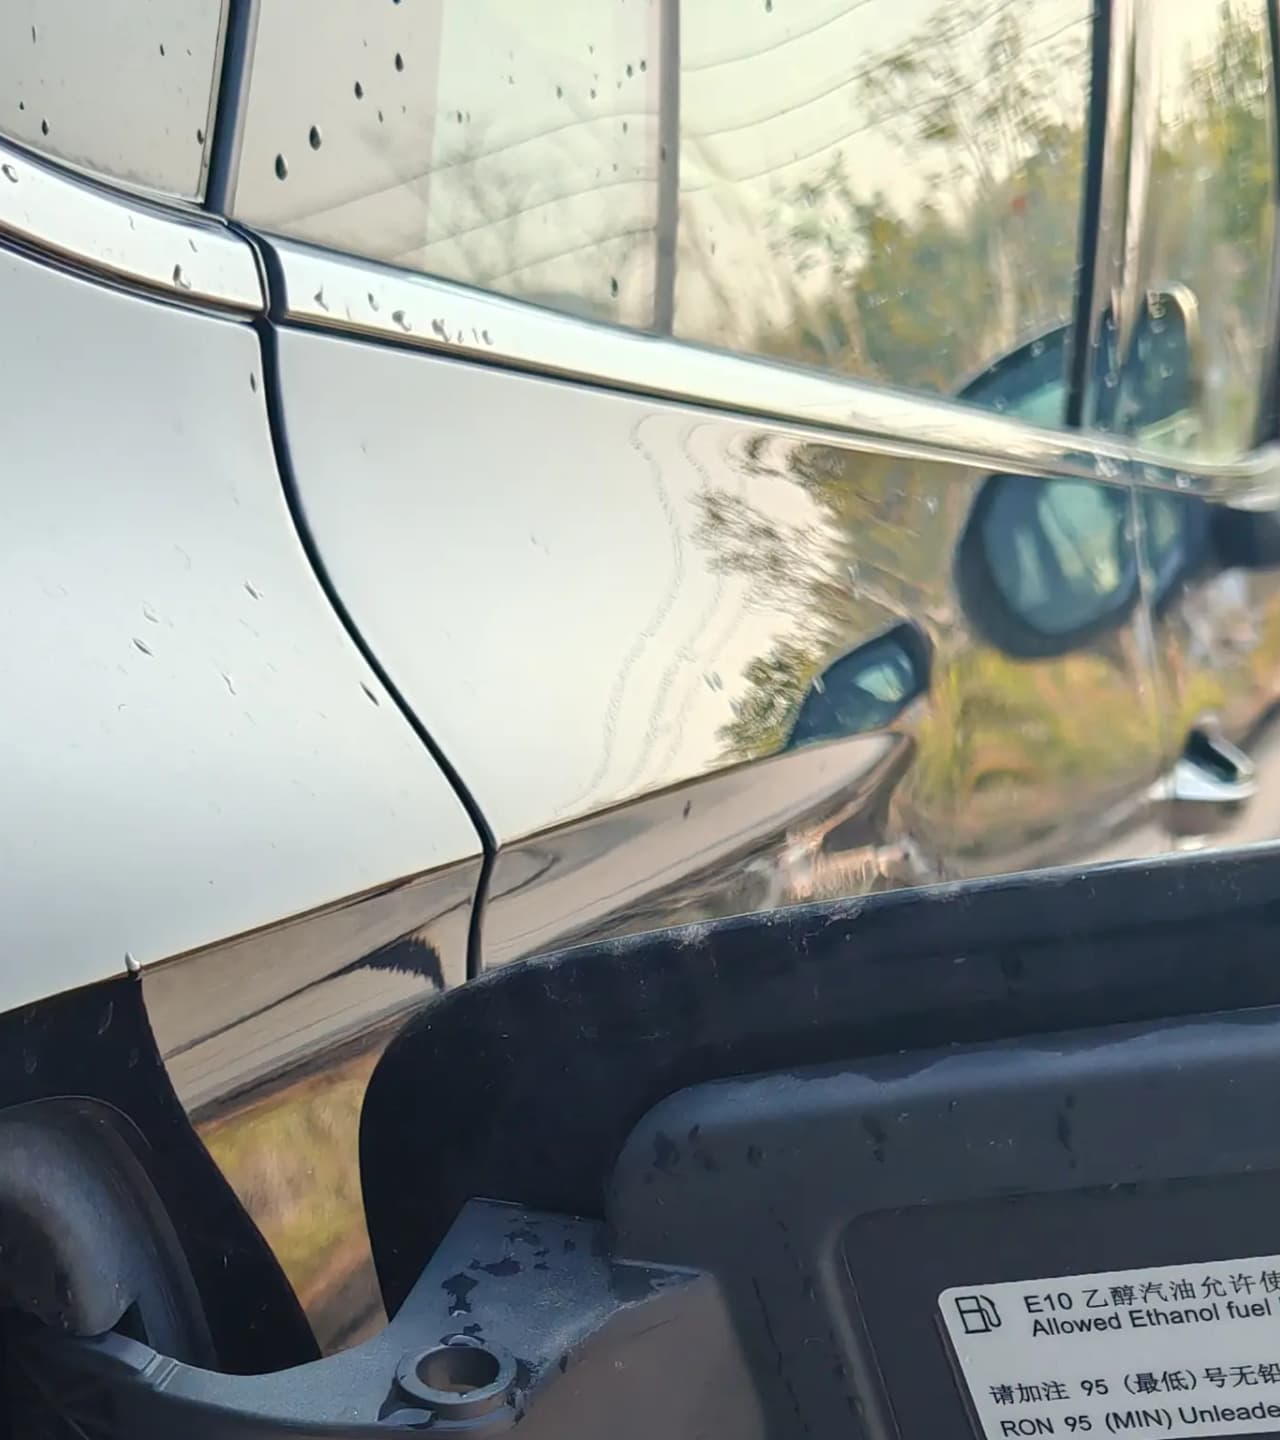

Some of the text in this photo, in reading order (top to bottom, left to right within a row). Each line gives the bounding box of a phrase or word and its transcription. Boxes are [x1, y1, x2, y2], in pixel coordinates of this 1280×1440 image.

[1024, 1292, 1073, 1313] E10
[1032, 1310, 1121, 1337] Allowed
[1131, 1303, 1220, 1329] Ethanol
[1227, 1298, 1271, 1320] fuel
[990, 1381, 1070, 1406] 请加注
[1080, 1379, 1109, 1397] 95
[1001, 1419, 1053, 1437] RON
[1064, 1416, 1093, 1433] 95
[1105, 1409, 1173, 1434] (MIN)
